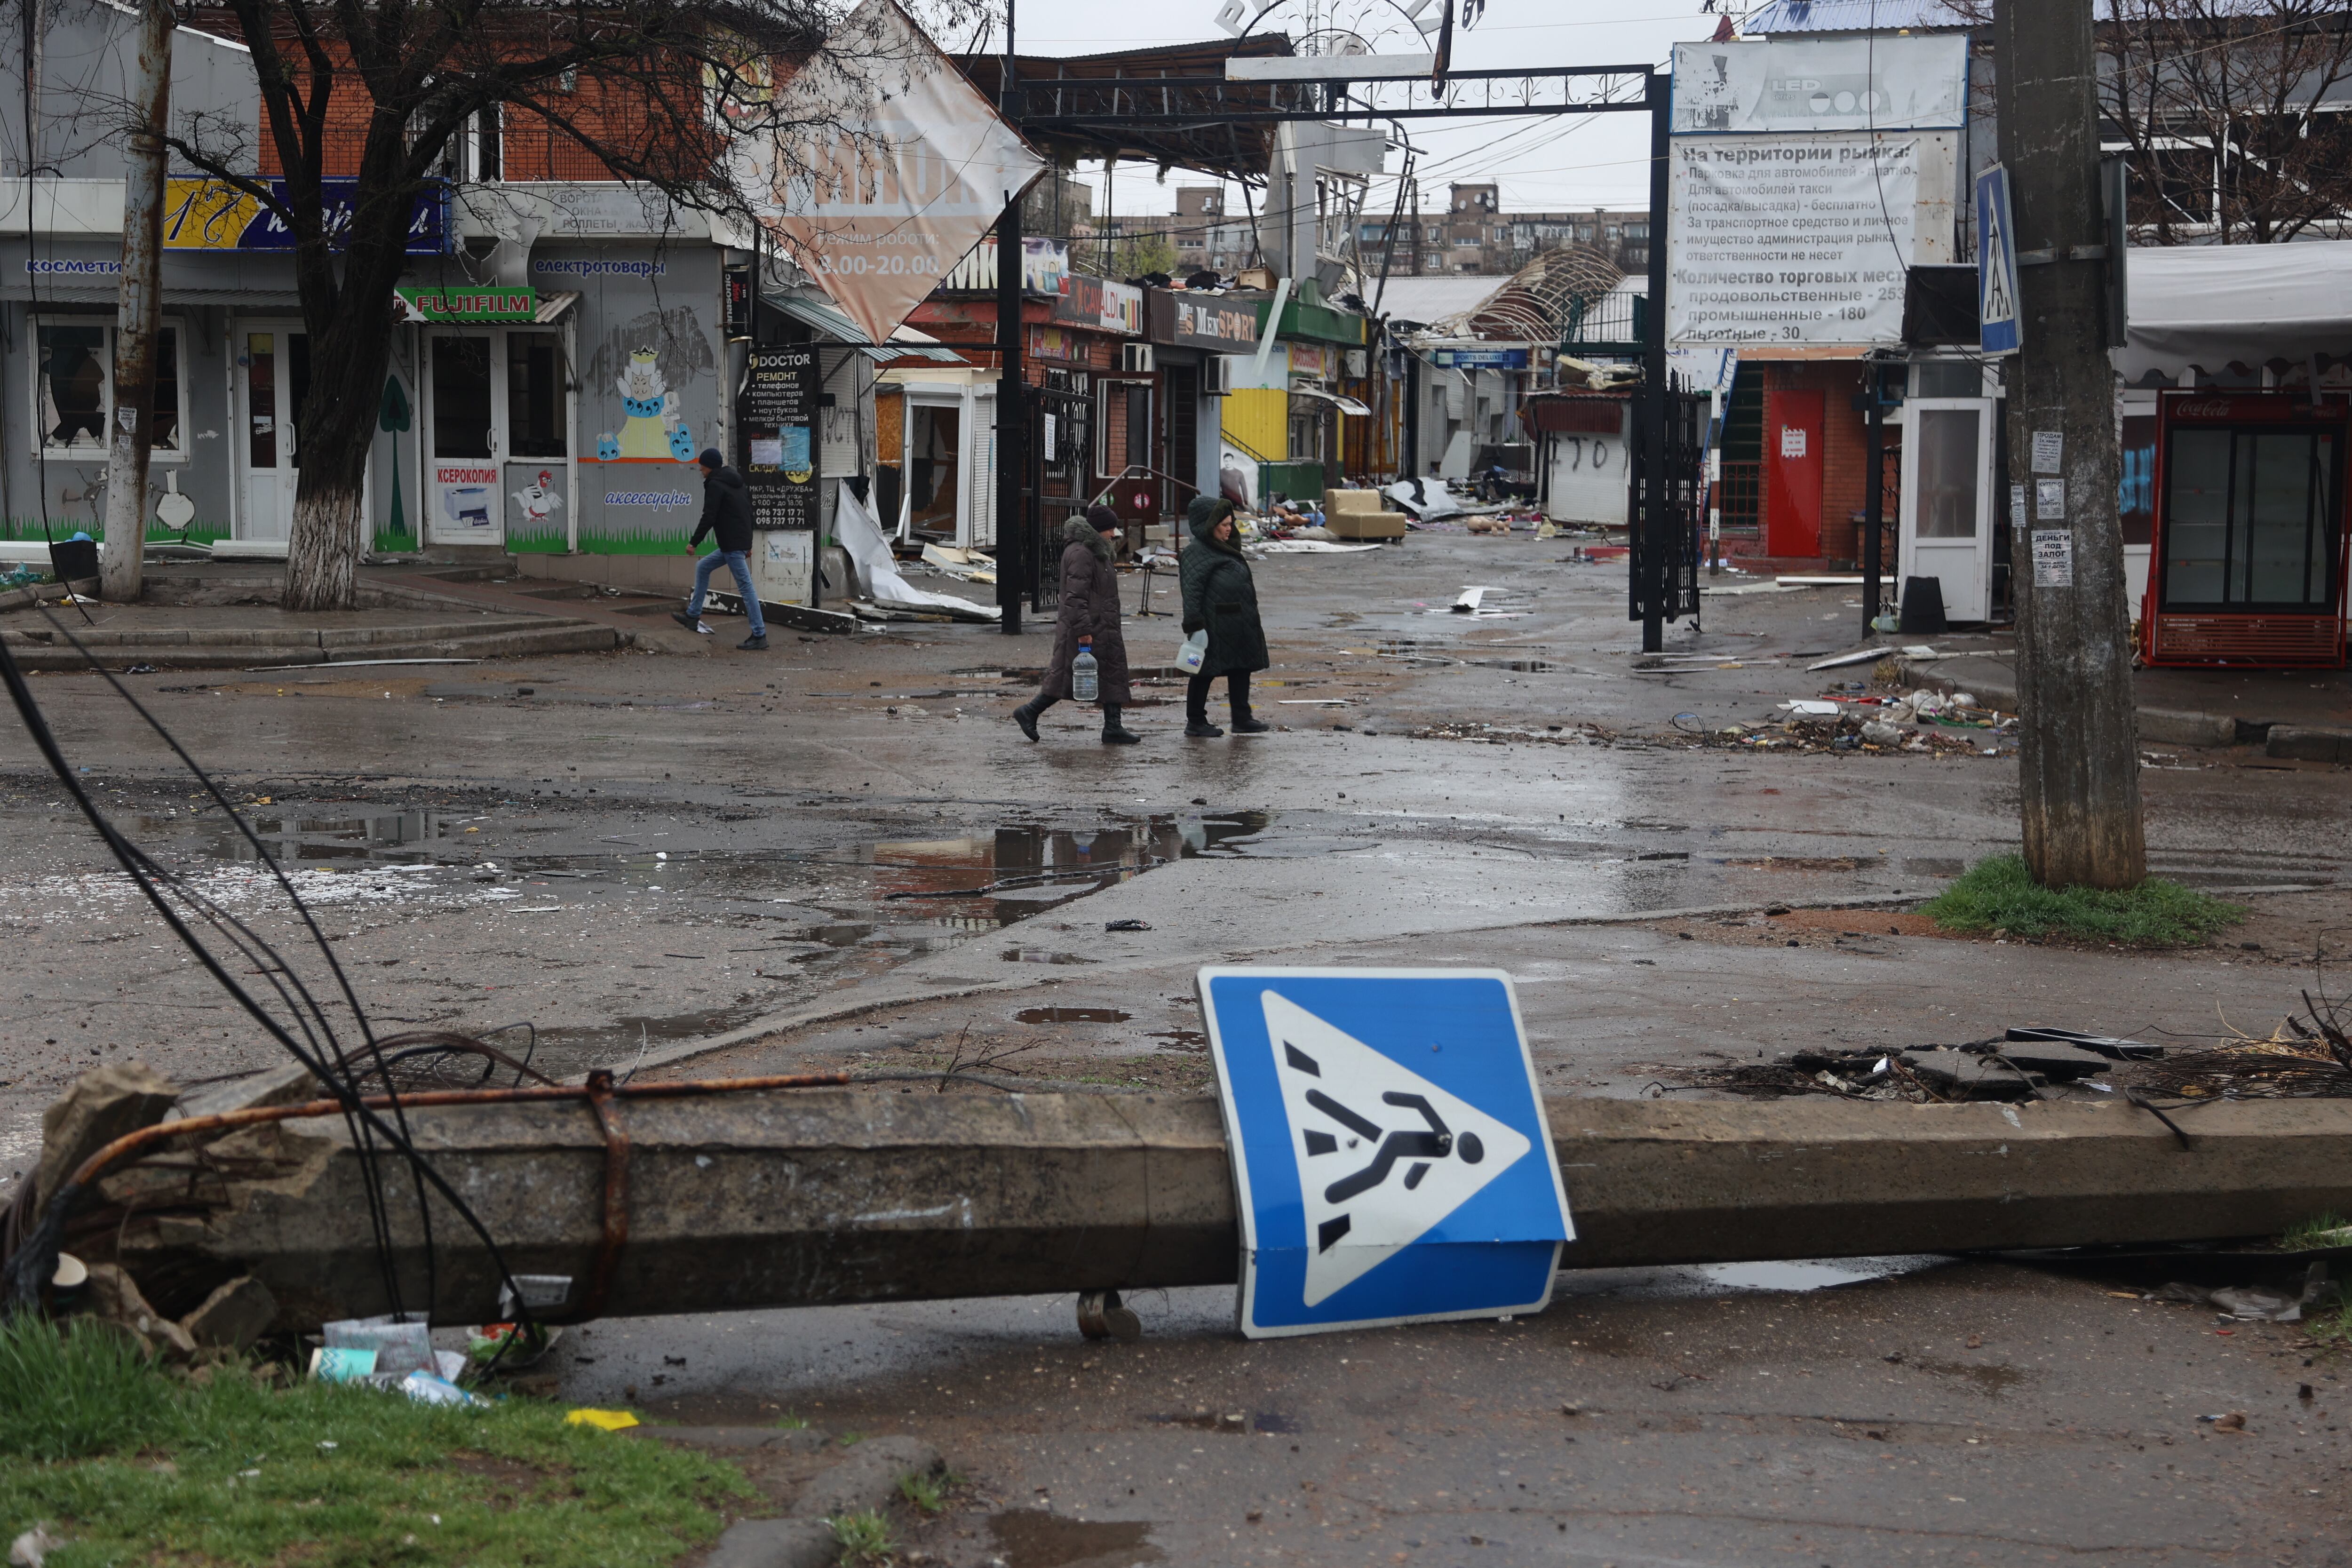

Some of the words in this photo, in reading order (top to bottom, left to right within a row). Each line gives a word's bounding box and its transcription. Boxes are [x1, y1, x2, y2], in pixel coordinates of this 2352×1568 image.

[1772, 80, 1821, 92] LED
[1684, 148, 1708, 162] На
[1715, 148, 1832, 165] территории
[1839, 147, 1910, 163] рынка:
[1690, 167, 1744, 181] Парковка
[1748, 170, 1770, 180] для
[1775, 166, 1856, 178] автомобилей
[1868, 167, 1910, 176] платно
[1688, 183, 1711, 196] Для
[1715, 183, 1795, 195] автомобилей
[1799, 185, 1832, 194] такси
[572, 207, 601, 216] ОКНА
[1688, 200, 1800, 214] (посадка/высадка)
[1812, 199, 1875, 210] бесплатно
[166, 186, 244, 242] 17
[563, 220, 616, 228] РОЛЛЕТЫ
[1687, 216, 1701, 228] За
[1705, 218, 1788, 230] транспортное
[1793, 218, 1849, 230] средство
[1863, 216, 1908, 226] личное
[876, 230, 939, 248] роботи:
[1687, 235, 1754, 247] имущество
[1757, 235, 1852, 246] администрация
[1857, 234, 1895, 246] рынка
[1686, 251, 1787, 261] ответственности
[1791, 251, 1805, 260] не
[1809, 251, 1843, 260] несет
[27, 260, 121, 273] космети
[535, 260, 666, 279] електротовары
[1677, 269, 1773, 283] Количество
[1779, 271, 1858, 287] торговых
[1084, 286, 1118, 319] CAVALDI
[1689, 291, 1862, 305] продовольственные
[1878, 287, 1905, 300] 253
[416, 295, 530, 312] FUJIFILM
[1688, 310, 1822, 324] промышненные
[1839, 307, 1866, 320] 180
[1686, 328, 1766, 340] льготные
[1782, 326, 1800, 340] 30
[759, 354, 810, 367] DOCTOR
[756, 372, 797, 381] РЕМОНТ
[759, 407, 798, 415] ноутбуков
[2177, 400, 2230, 417] Coca-Cola
[438, 469, 496, 483] КСЕРОКОПИЯ
[605, 489, 691, 511] аксессуары
